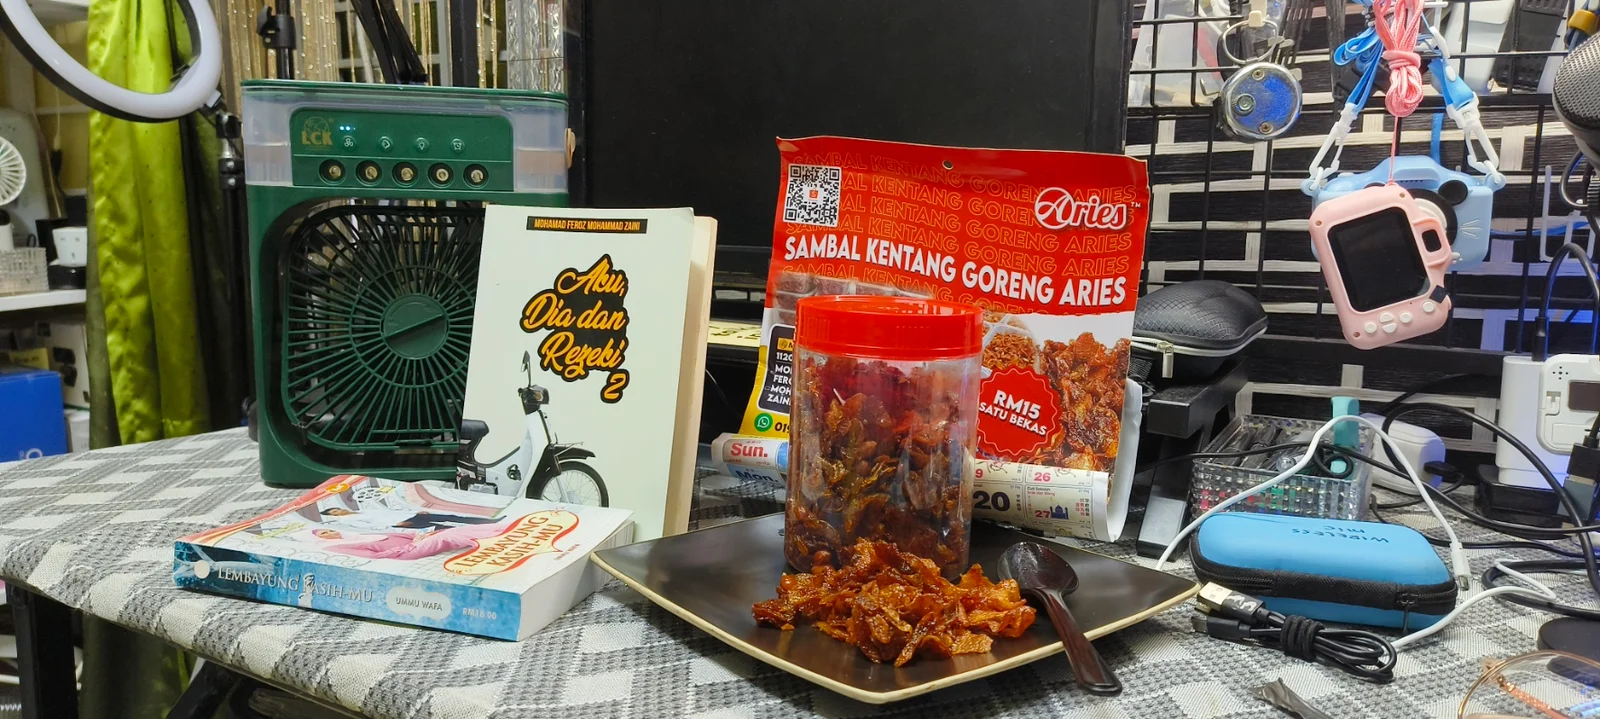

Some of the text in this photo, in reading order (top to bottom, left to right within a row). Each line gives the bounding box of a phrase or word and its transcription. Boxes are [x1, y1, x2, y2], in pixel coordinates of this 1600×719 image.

[870, 154, 965, 188] KENTANG
[970, 175, 1047, 204] GOREN
[872, 174, 964, 211] KENTANG
[968, 197, 1043, 228] GOREN
[1034, 186, 1128, 231] Aries
[534, 218, 641, 231] MOHAMAD FEROZ MOHAMMAD ZAINI
[870, 196, 962, 233] KENTANG
[965, 219, 1060, 252] GORENG
[1063, 231, 1133, 255] ARIES
[867, 216, 960, 254] KENTANG
[963, 241, 1058, 275] GORENG
[1061, 255, 1130, 277] ARIES
[557, 258, 625, 296] Aku,
[784, 233, 1128, 308] SAMBAL KENTANG GORENG ARIES
[523, 293, 626, 331] Dia dan
[541, 331, 626, 378] Rezeki
[604, 372, 627, 399] 2
[993, 389, 1042, 419] RM15
[978, 402, 1048, 435] SATU BEKAS
[730, 442, 769, 458] Sun.
[1033, 471, 1052, 482] 26
[972, 490, 1011, 512] 20
[1035, 509, 1051, 519] 27
[454, 515, 550, 568] LEMBAYUNG
[485, 523, 564, 568] KASIH-MU
[217, 566, 300, 592] LEMBAYUNG
[395, 596, 420, 608] UMMU
[421, 600, 443, 612] WAFA
